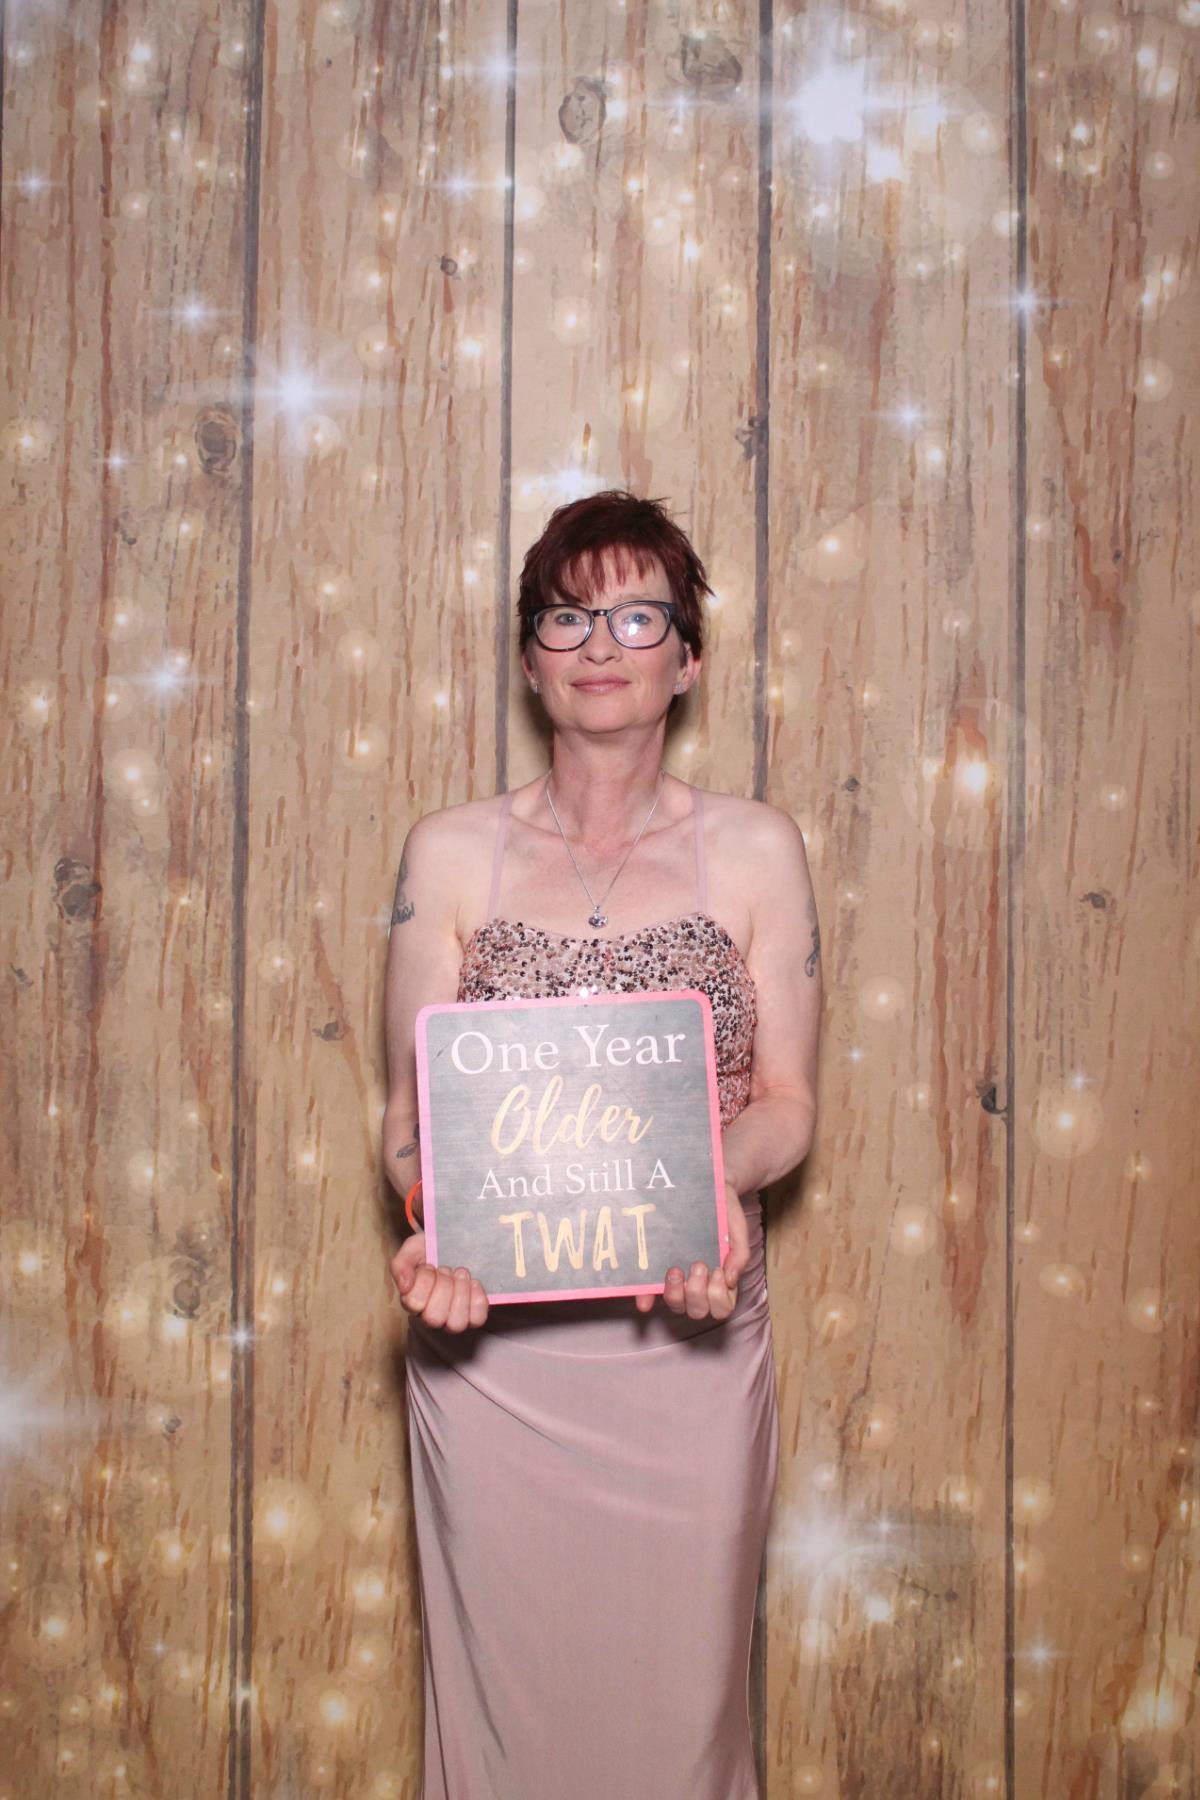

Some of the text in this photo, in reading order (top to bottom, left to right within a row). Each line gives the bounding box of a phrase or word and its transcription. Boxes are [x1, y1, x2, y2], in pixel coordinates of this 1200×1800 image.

[451, 1024, 686, 1074] One Year
[491, 1075, 653, 1155] Older
[477, 1159, 675, 1200] And Still A
[498, 1203, 657, 1278] TWAT
